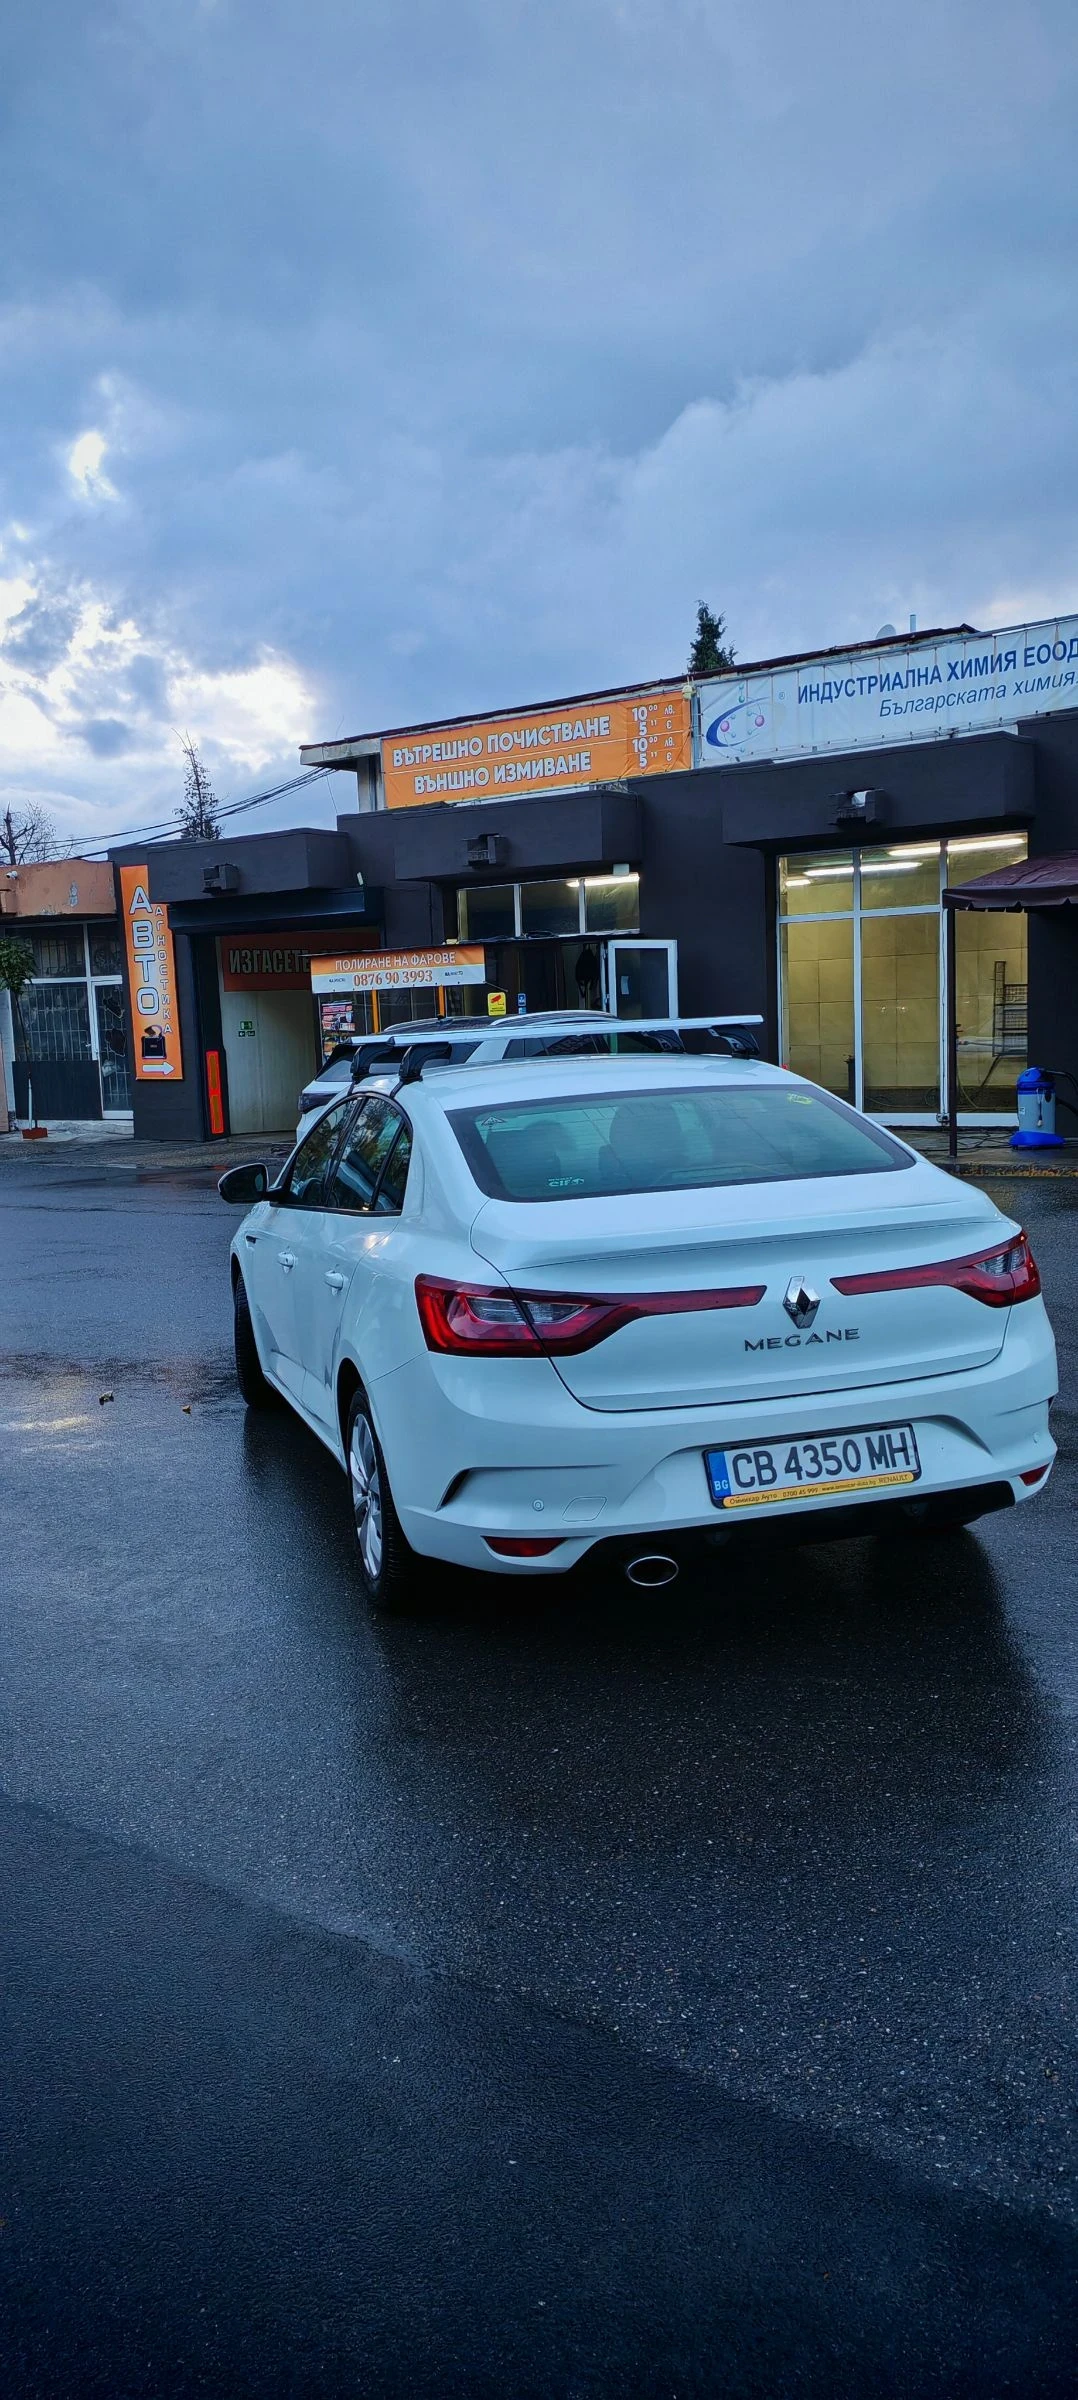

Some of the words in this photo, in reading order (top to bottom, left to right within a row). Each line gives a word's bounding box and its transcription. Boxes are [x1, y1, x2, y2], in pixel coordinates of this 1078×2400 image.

[798, 665, 942, 705] ИНДУСТРИАЛНА
[947, 650, 1017, 681] ХИМИЯ
[1024, 637, 1078, 668] ЕООД
[879, 682, 1007, 717] Българската
[393, 737, 483, 767] ВЪТРЕШНО
[487, 715, 611, 754] ПОЧИСТВАНЕ
[639, 721, 648, 736] 5
[414, 767, 489, 794] ВЪНШНО
[494, 751, 592, 783] ИЗМИВАНЕ
[639, 753, 648, 767] 5
[129, 886, 160, 1016] АВТО
[335, 956, 392, 971] ПОЛИРАНЕ
[394, 954, 408, 967] НА
[410, 952, 456, 966] ФАРОВЕ
[154, 905, 173, 1034] АГНОСТИКА
[353, 973, 382, 987] 0876
[386, 971, 399, 985] 90
[402, 970, 433, 984] 3993
[744, 1328, 860, 1351] MEGANE
[784, 1439, 861, 1481] 4350
[714, 1480, 729, 1491] BG
